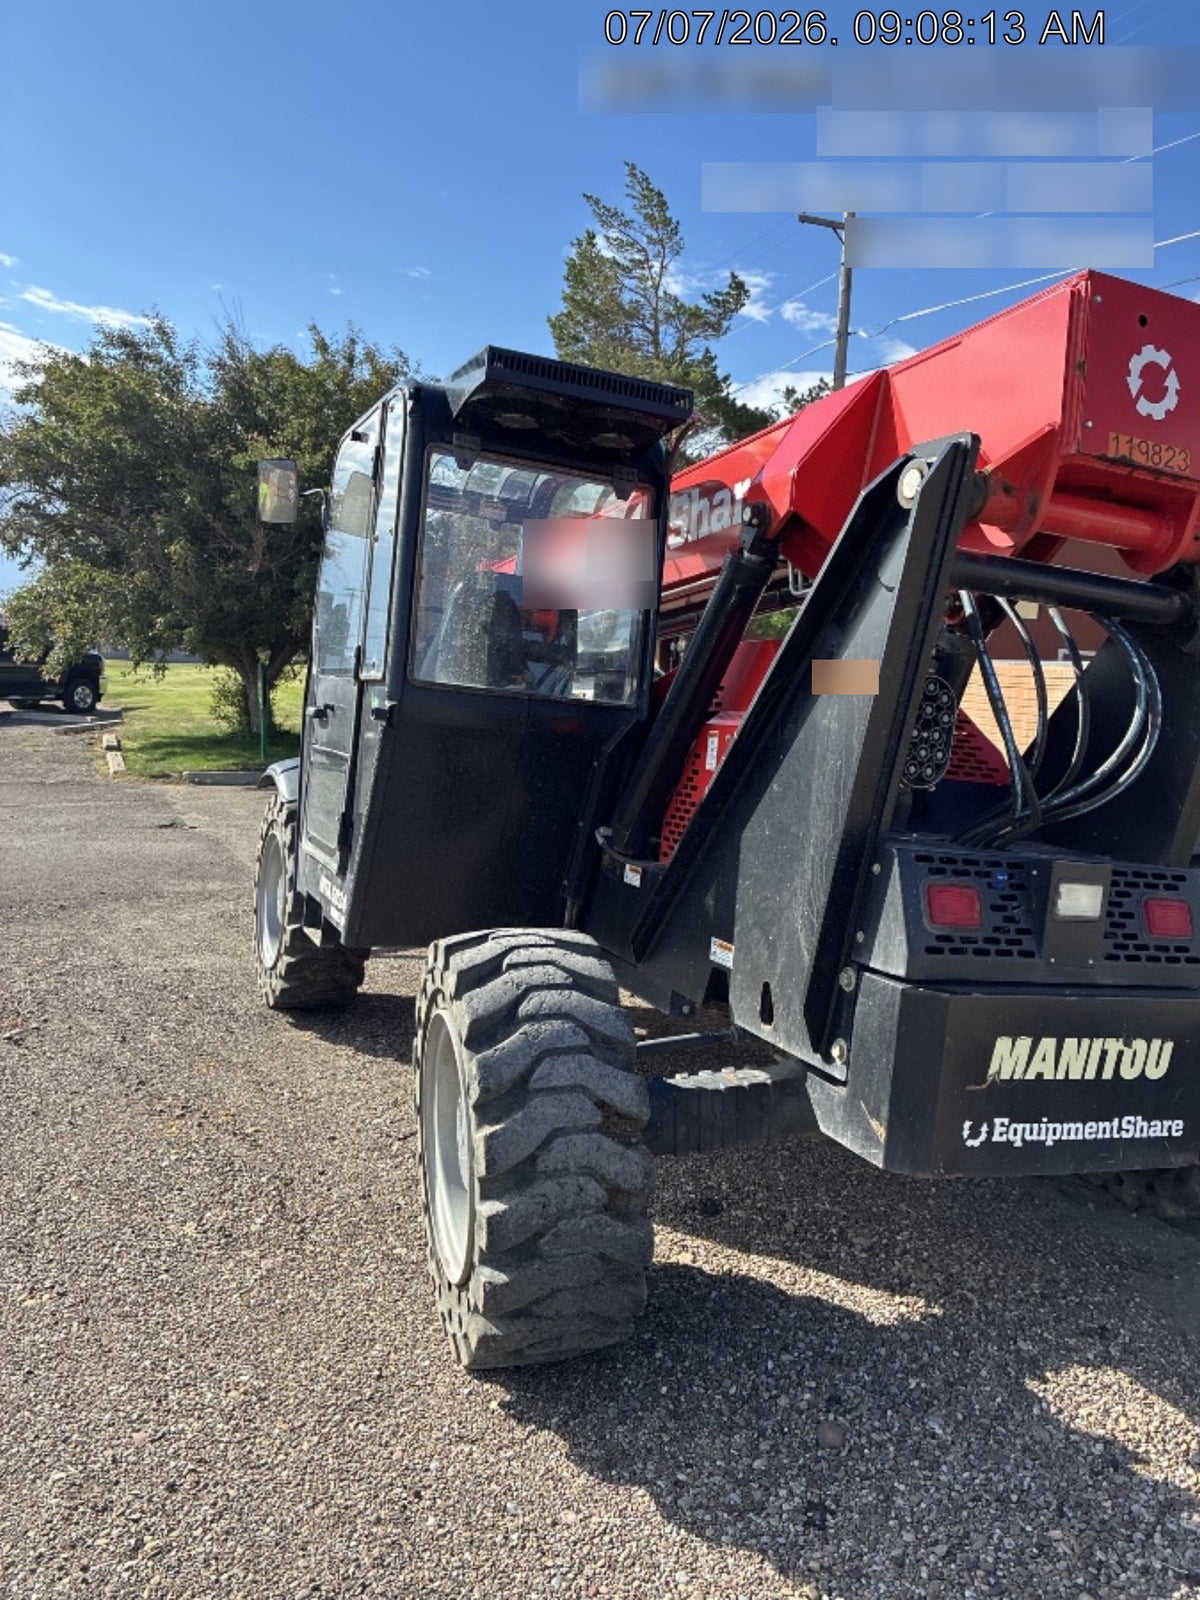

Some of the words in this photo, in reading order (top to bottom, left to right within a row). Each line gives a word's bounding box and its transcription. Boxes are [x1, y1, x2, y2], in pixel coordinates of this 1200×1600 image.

[1109, 433, 1191, 473] 119823
[988, 1036, 1174, 1080] MANITOU
[991, 1115, 1184, 1147] EquipmentShare
